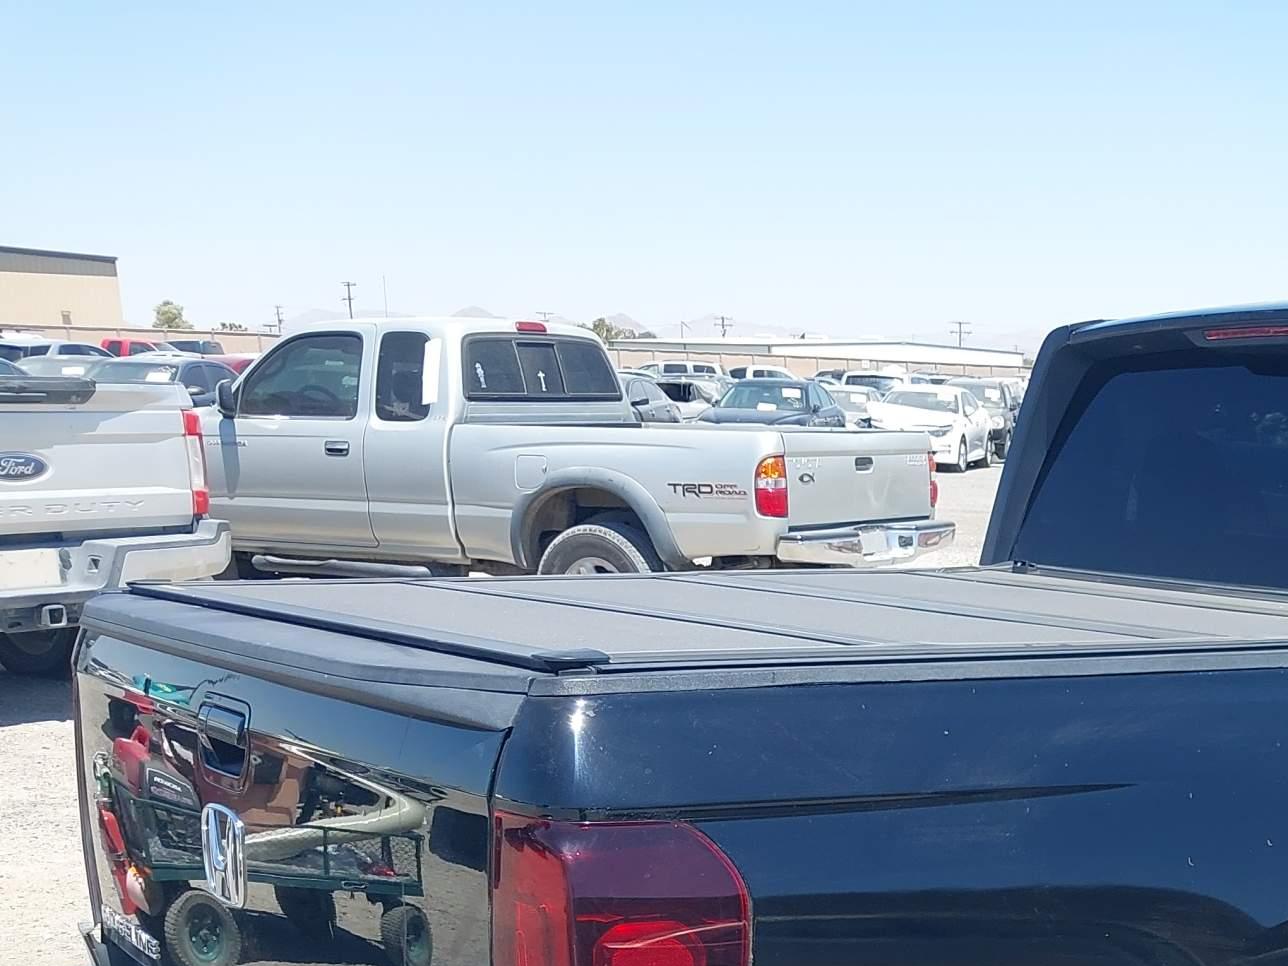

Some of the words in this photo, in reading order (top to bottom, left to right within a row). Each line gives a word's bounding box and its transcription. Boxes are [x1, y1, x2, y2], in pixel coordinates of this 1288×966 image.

[0, 457, 35, 475] Ford
[667, 483, 713, 498] TRD
[44, 499, 145, 515] DUTY
